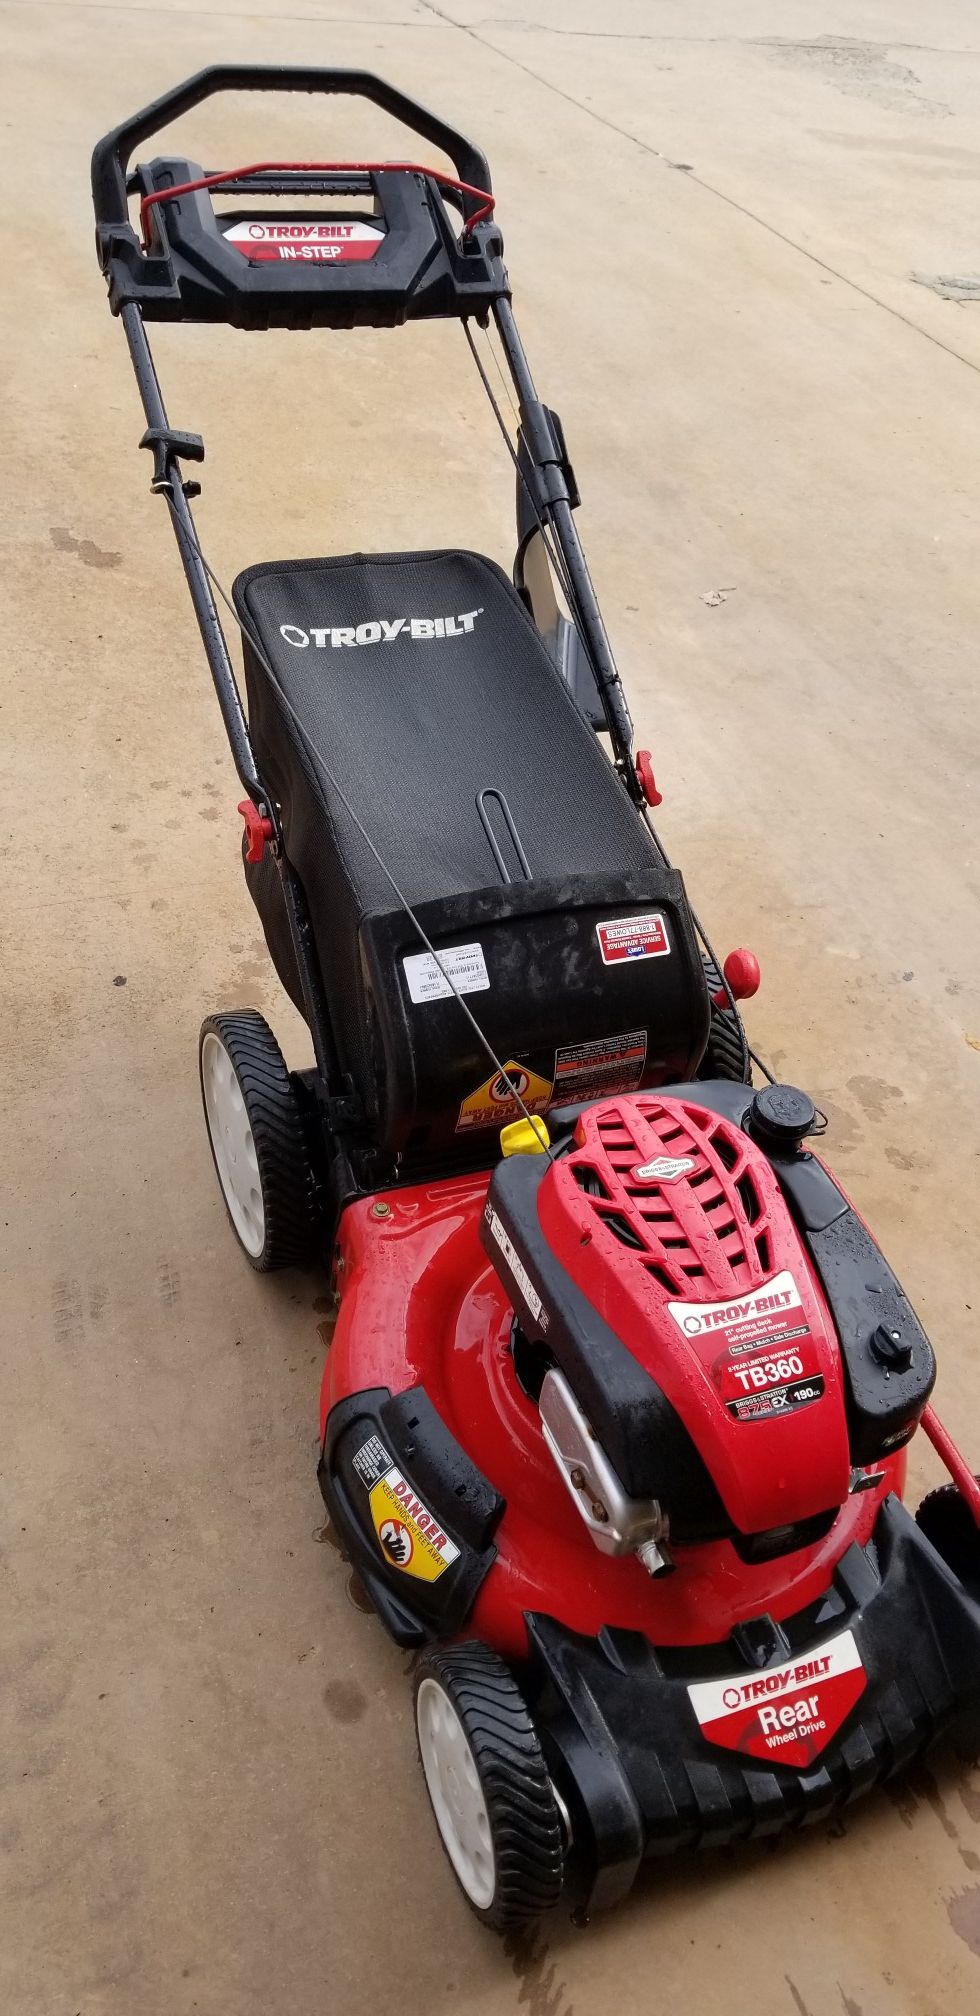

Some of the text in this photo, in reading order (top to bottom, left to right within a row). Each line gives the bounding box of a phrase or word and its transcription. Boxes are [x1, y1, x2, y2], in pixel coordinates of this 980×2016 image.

[266, 226, 353, 238] TROY-BILT
[279, 246, 341, 259] IN-STEP
[310, 610, 479, 648] TROY-BILT
[607, 938, 639, 951] ADVANTAGE
[639, 935, 662, 945] SERVICE
[701, 1290, 792, 1329] TROY-BILT
[727, 1321, 788, 1342] self-propelled mower
[736, 1323, 757, 1333] cutting
[757, 1318, 772, 1327] deck
[747, 1356, 769, 1367] LIMITED
[769, 1347, 800, 1360] WARRANTY
[734, 1355, 803, 1390] TB360
[381, 1484, 445, 1567] KEEP HANDS and FEET AWAY
[392, 1480, 448, 1552] DANGER
[740, 1655, 832, 1702] TROY-BILT
[757, 1695, 819, 1735] Rear
[765, 1720, 826, 1749] Wheel Drive
